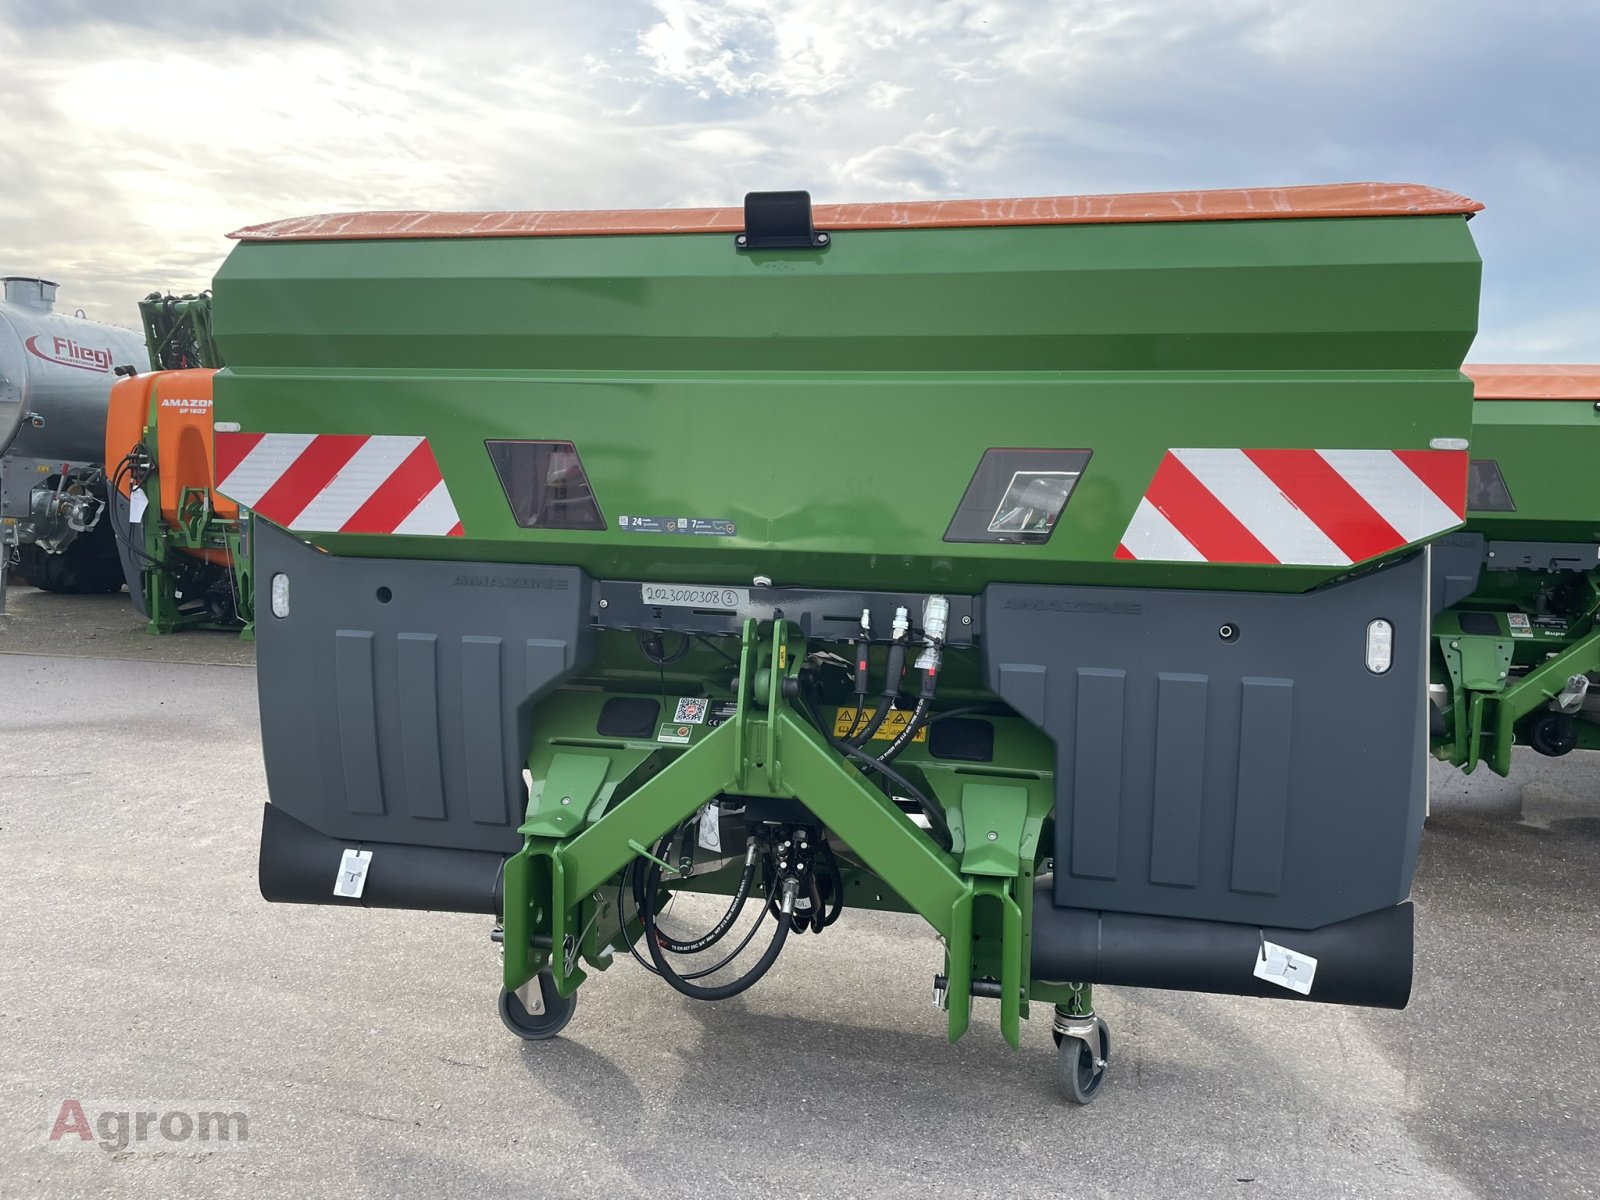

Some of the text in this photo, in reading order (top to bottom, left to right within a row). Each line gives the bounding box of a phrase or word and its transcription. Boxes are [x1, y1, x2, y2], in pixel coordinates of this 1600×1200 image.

[53, 335, 113, 369] Fliegl
[632, 517, 642, 526] 24
[691, 519, 697, 528] 7
[453, 575, 569, 590] AMAZONE
[646, 587, 720, 604] 2023000308
[1000, 598, 1143, 615] AMAZONE
